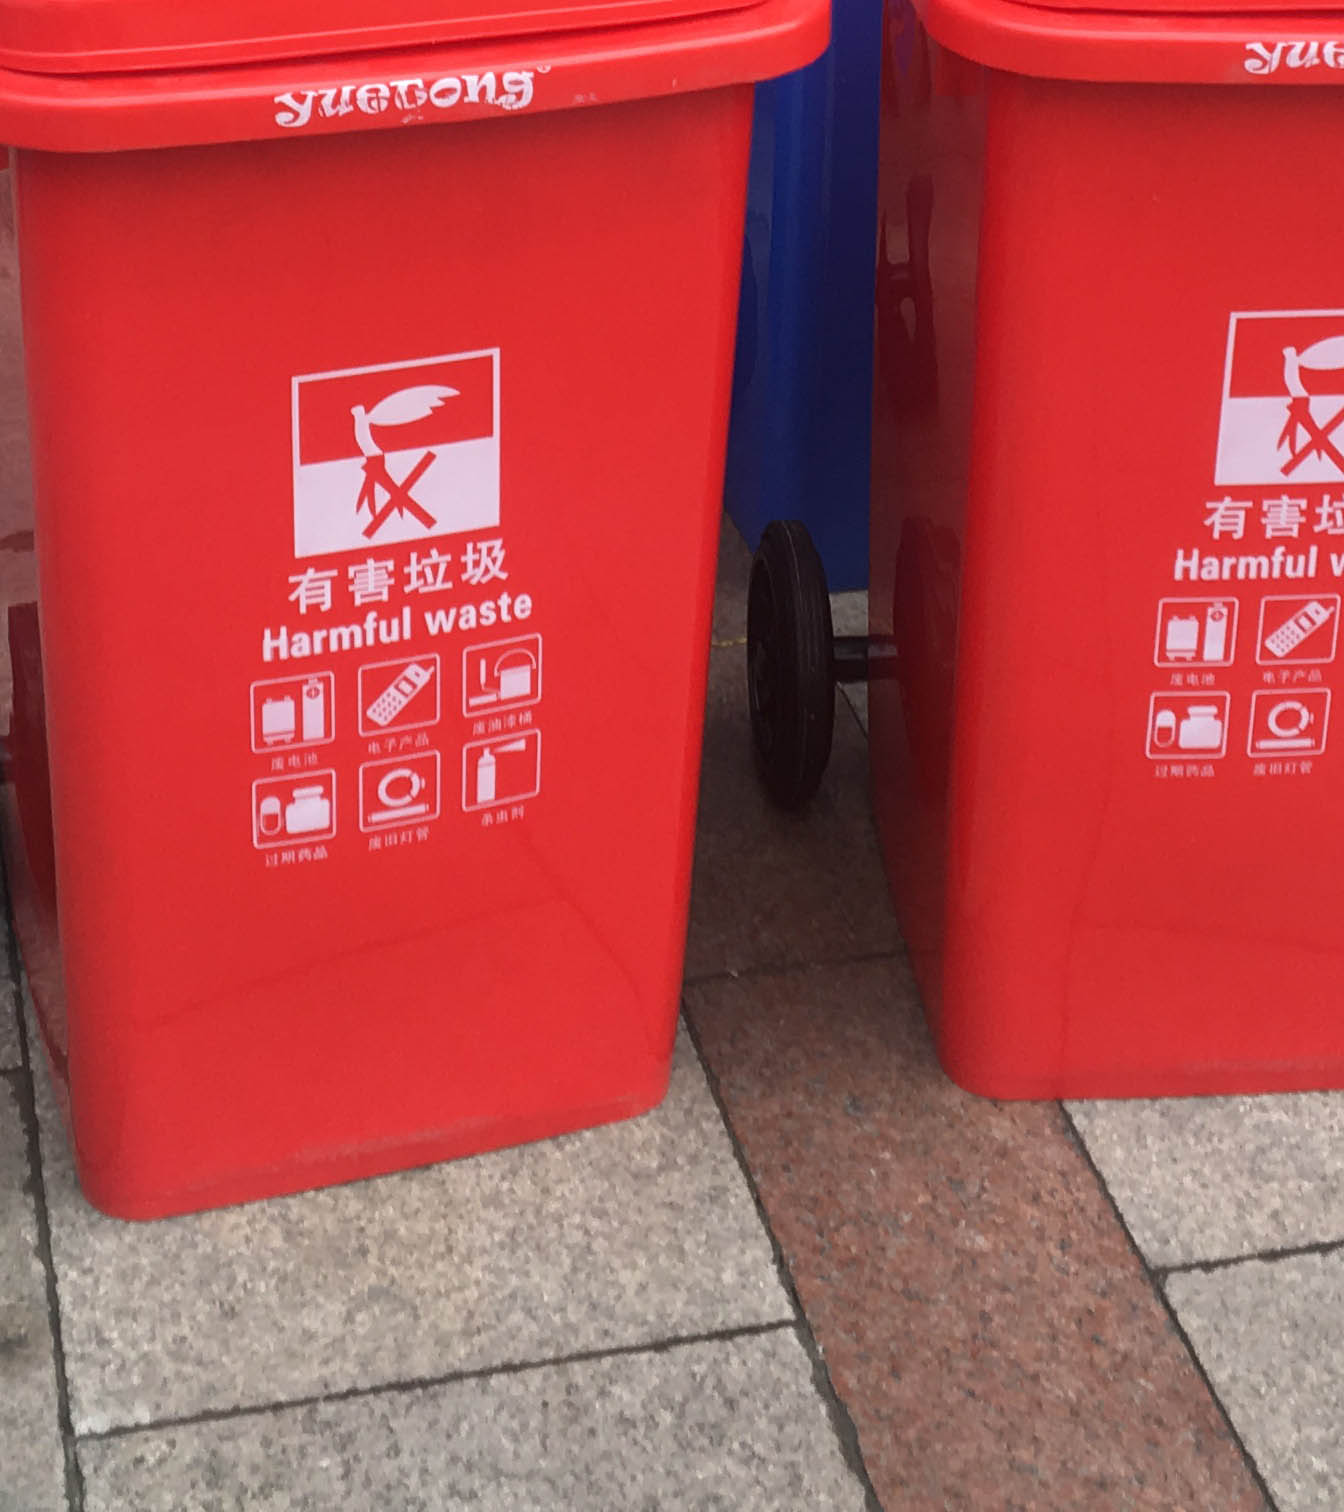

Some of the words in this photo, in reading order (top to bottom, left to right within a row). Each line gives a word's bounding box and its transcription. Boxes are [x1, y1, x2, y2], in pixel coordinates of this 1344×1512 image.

[288, 538, 509, 615] 有害垃圾
[1174, 545, 1318, 581] Harmful
[262, 606, 411, 662] Harmful
[424, 592, 533, 636] waste
[1262, 669, 1322, 684] 电子产品
[367, 732, 430, 755] 电子产品
